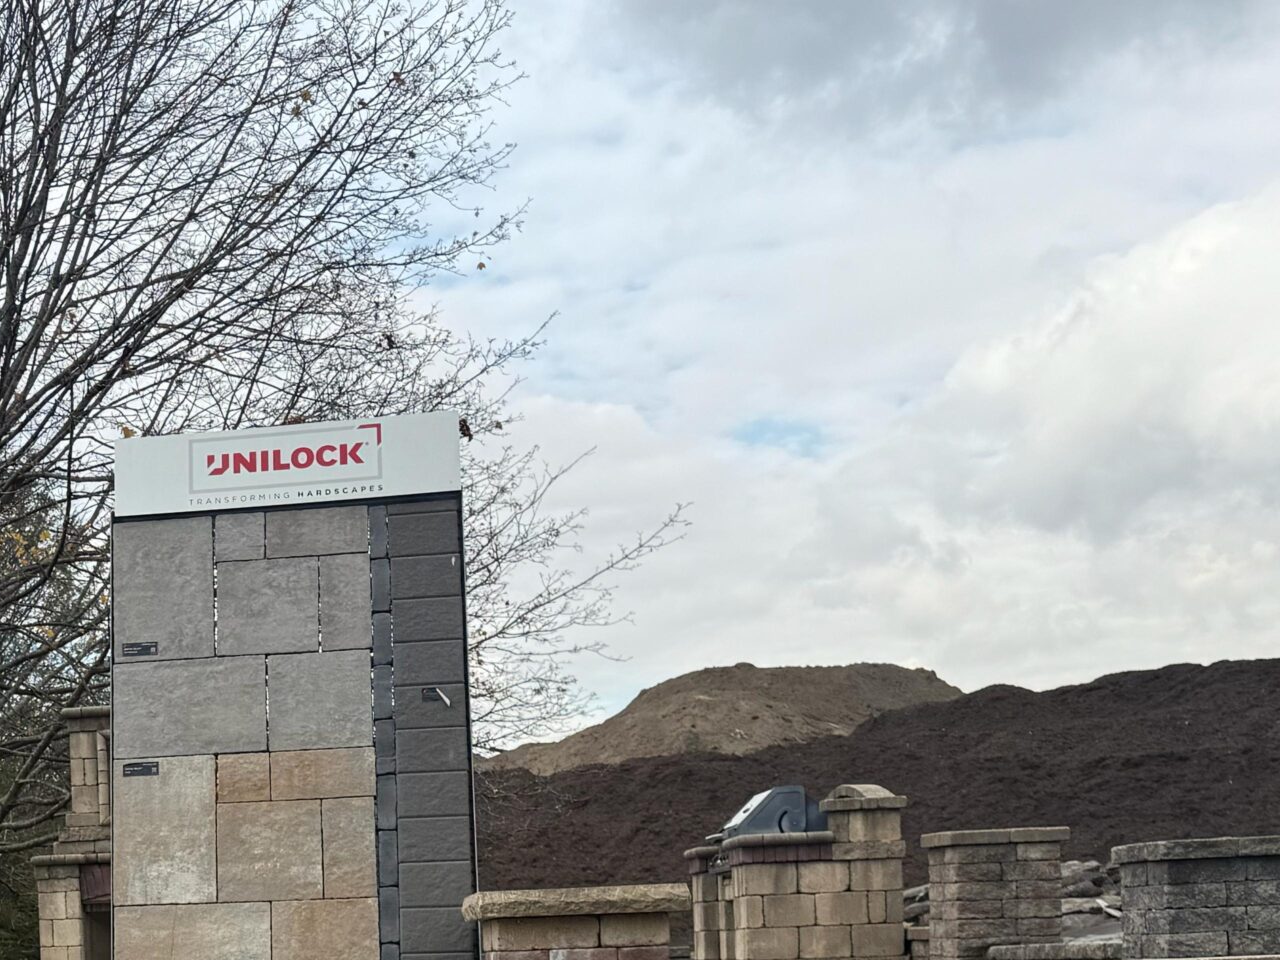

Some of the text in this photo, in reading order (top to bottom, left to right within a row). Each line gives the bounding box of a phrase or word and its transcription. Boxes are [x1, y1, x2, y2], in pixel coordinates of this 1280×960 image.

[206, 442, 365, 476] UNILOCK
[189, 484, 384, 506] TRANSFORMING HARDSCAPES
